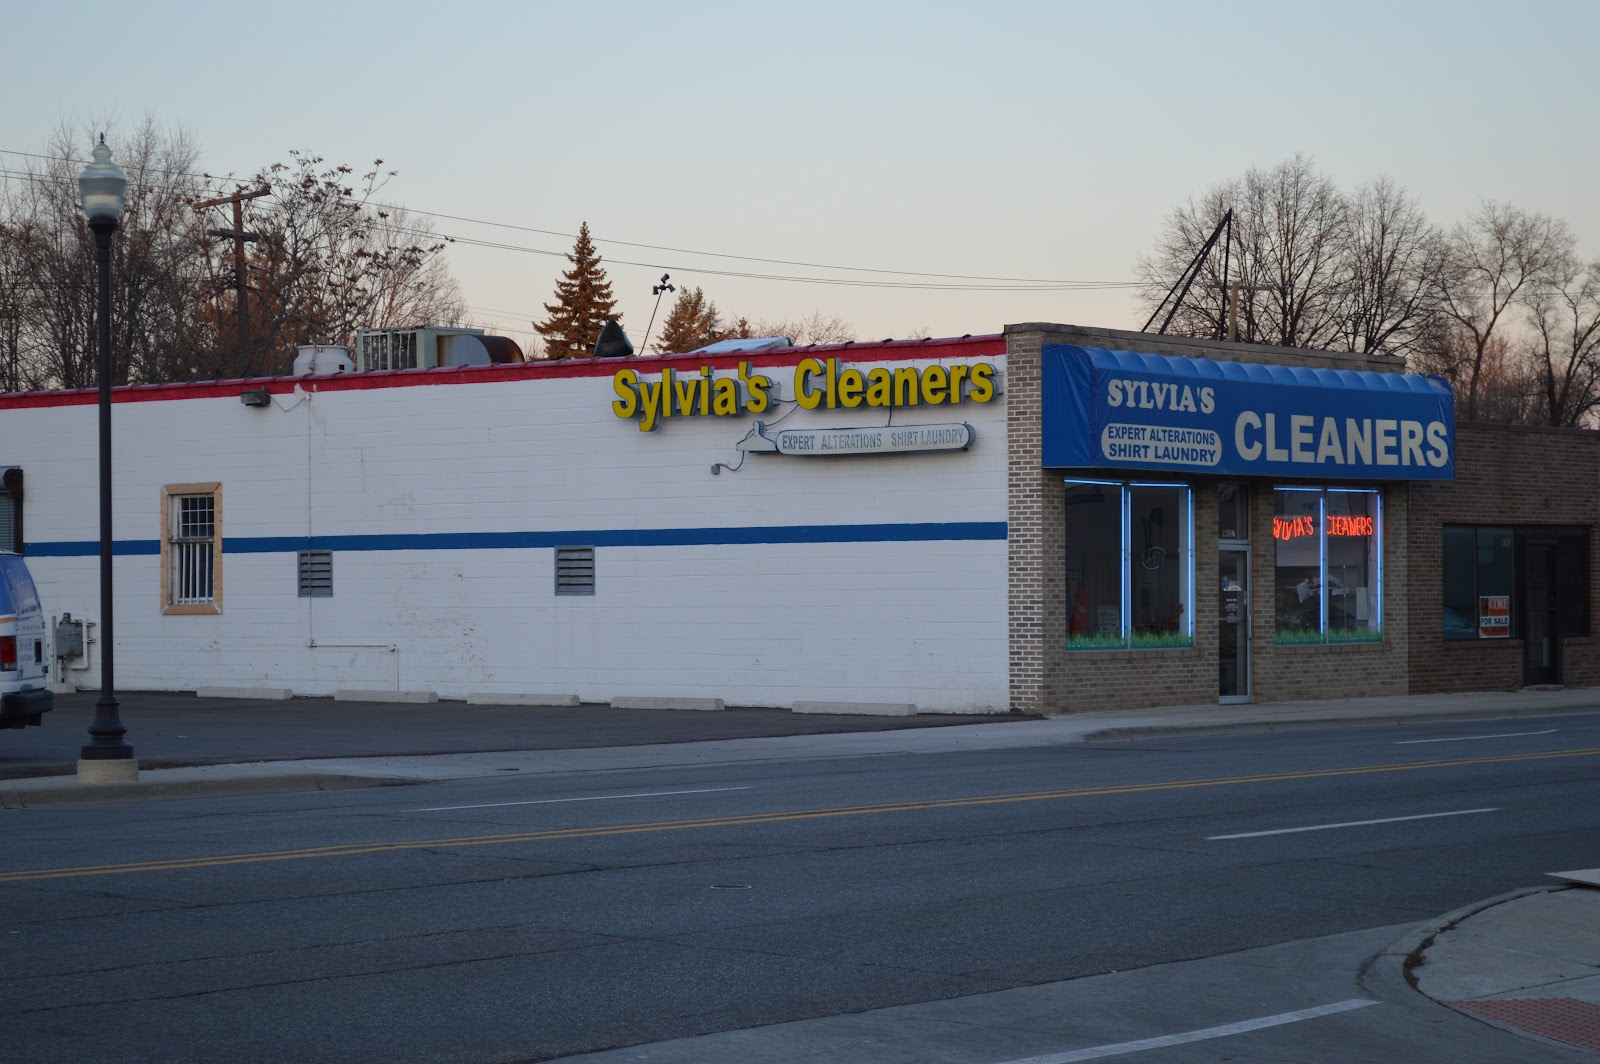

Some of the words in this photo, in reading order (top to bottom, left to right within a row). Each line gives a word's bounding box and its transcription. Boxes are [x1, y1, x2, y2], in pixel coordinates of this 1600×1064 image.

[612, 361, 771, 432] Sylvia's
[794, 357, 998, 411] Cleaners
[1107, 378, 1216, 415] SYLVIA'S
[782, 435, 816, 450] EXPERT
[821, 433, 882, 450] ALTERATIONS
[891, 430, 919, 447] SHIRT
[921, 428, 965, 446] LAUNDRY
[1108, 425, 1146, 441] EXPERT
[1149, 427, 1216, 446] ALTERATIONS
[1234, 410, 1450, 468] CLEANERS
[1108, 443, 1150, 459] SHIRT
[1153, 445, 1217, 463] LAUNDRY
[1481, 618, 1492, 626] FOR
[1493, 617, 1508, 625] SALE
